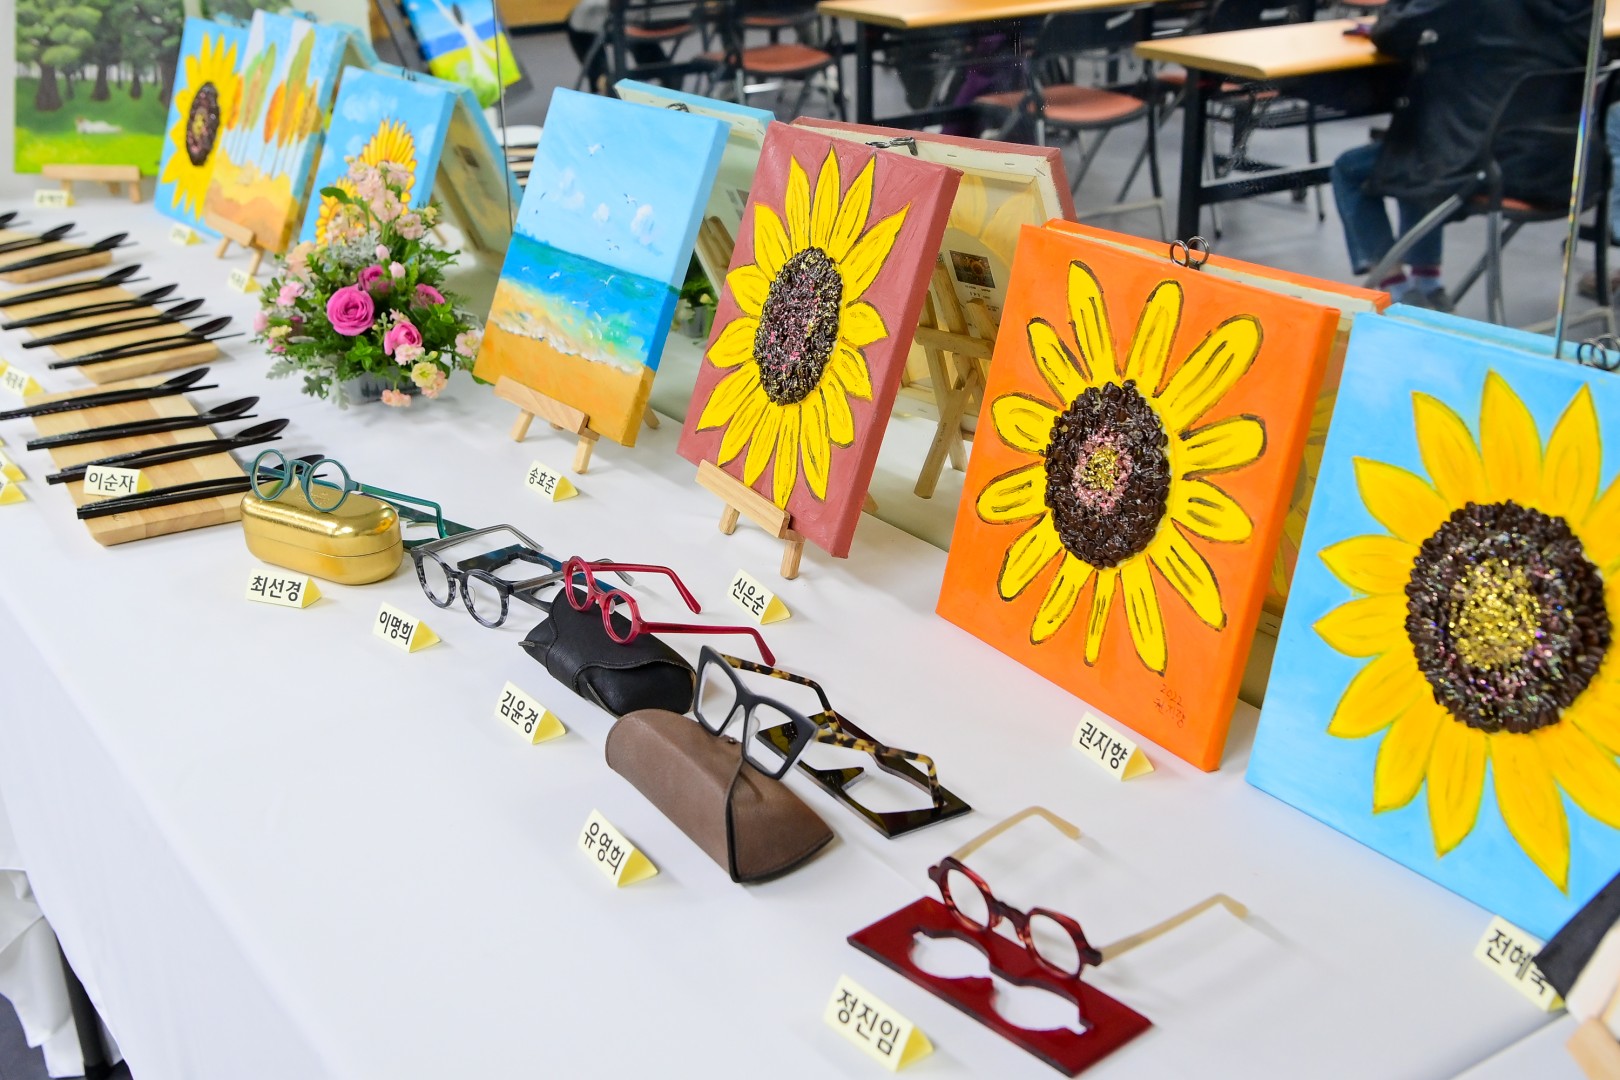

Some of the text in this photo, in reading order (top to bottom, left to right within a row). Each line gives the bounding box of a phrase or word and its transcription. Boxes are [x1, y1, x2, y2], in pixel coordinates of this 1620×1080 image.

[89, 472, 134, 493] 이순자
[529, 467, 556, 494] 송효준
[250, 575, 302, 602] 최선경
[732, 577, 765, 616] 신은순
[379, 611, 414, 645] 이명희
[500, 690, 539, 734] 김윤경
[1079, 721, 1128, 770] 권지향
[584, 822, 625, 875] 유영희
[836, 988, 900, 1056] 정진임
